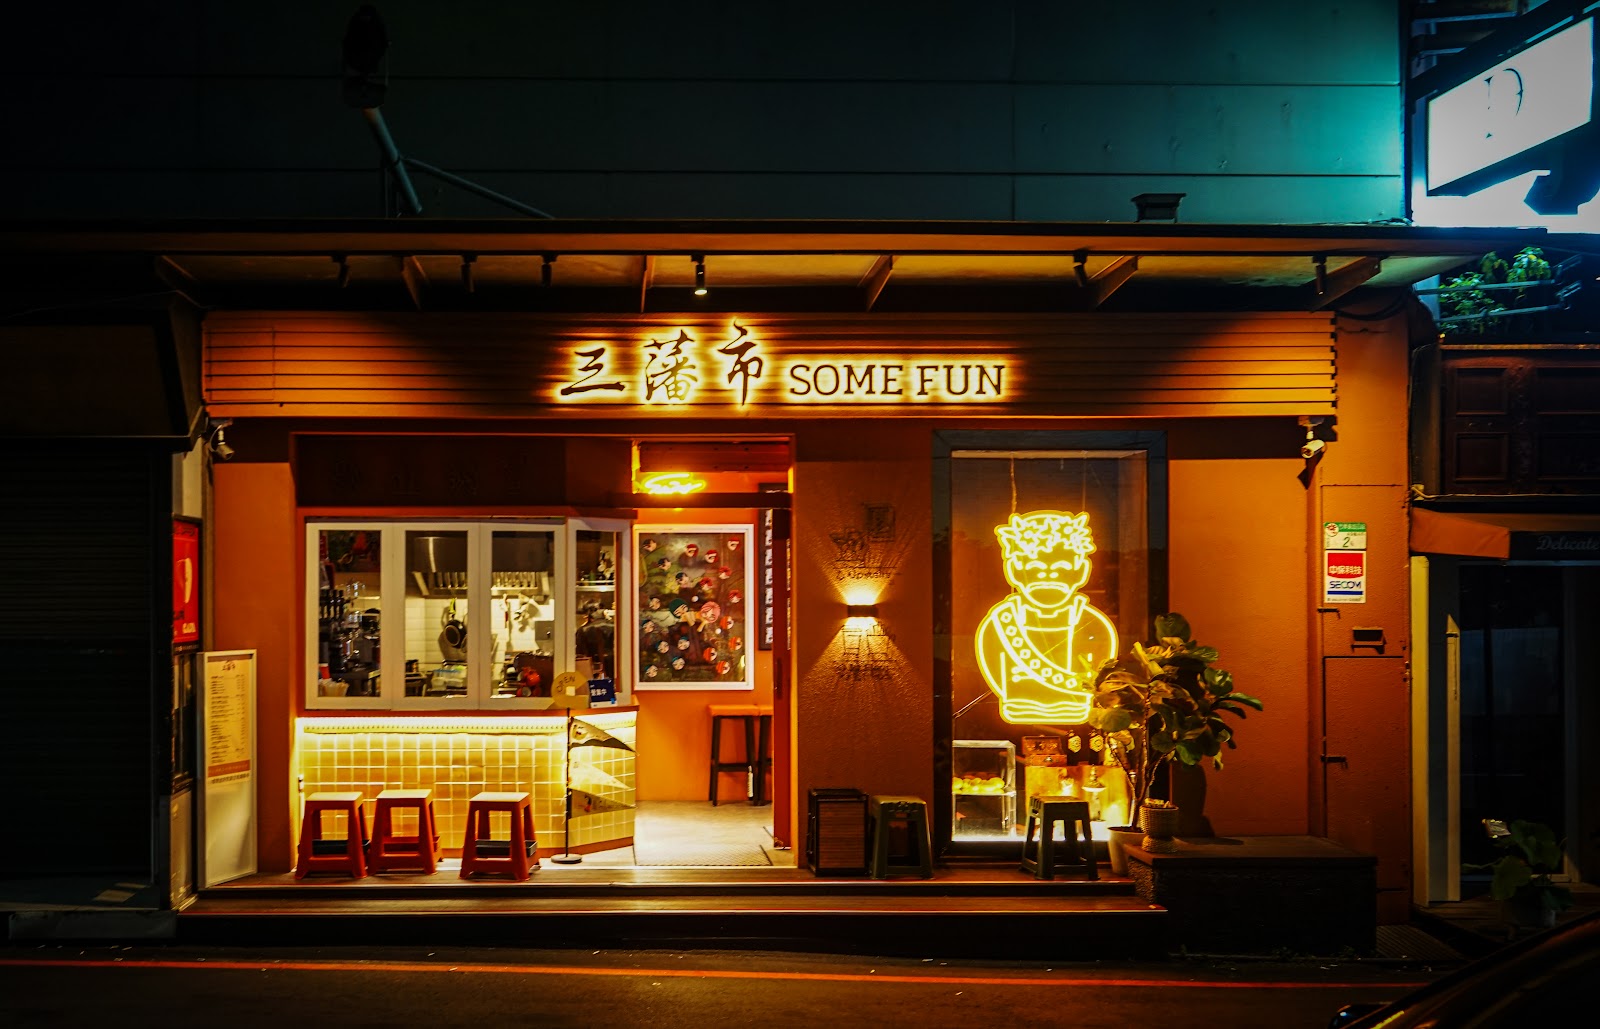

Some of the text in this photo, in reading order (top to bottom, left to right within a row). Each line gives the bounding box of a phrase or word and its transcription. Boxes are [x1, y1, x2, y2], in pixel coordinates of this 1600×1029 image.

[560, 318, 1005, 406] 三藩市 SOME FUN
[1342, 536, 1351, 548] 2
[1330, 580, 1361, 589] SECOM
[557, 676, 575, 692] OPEN
